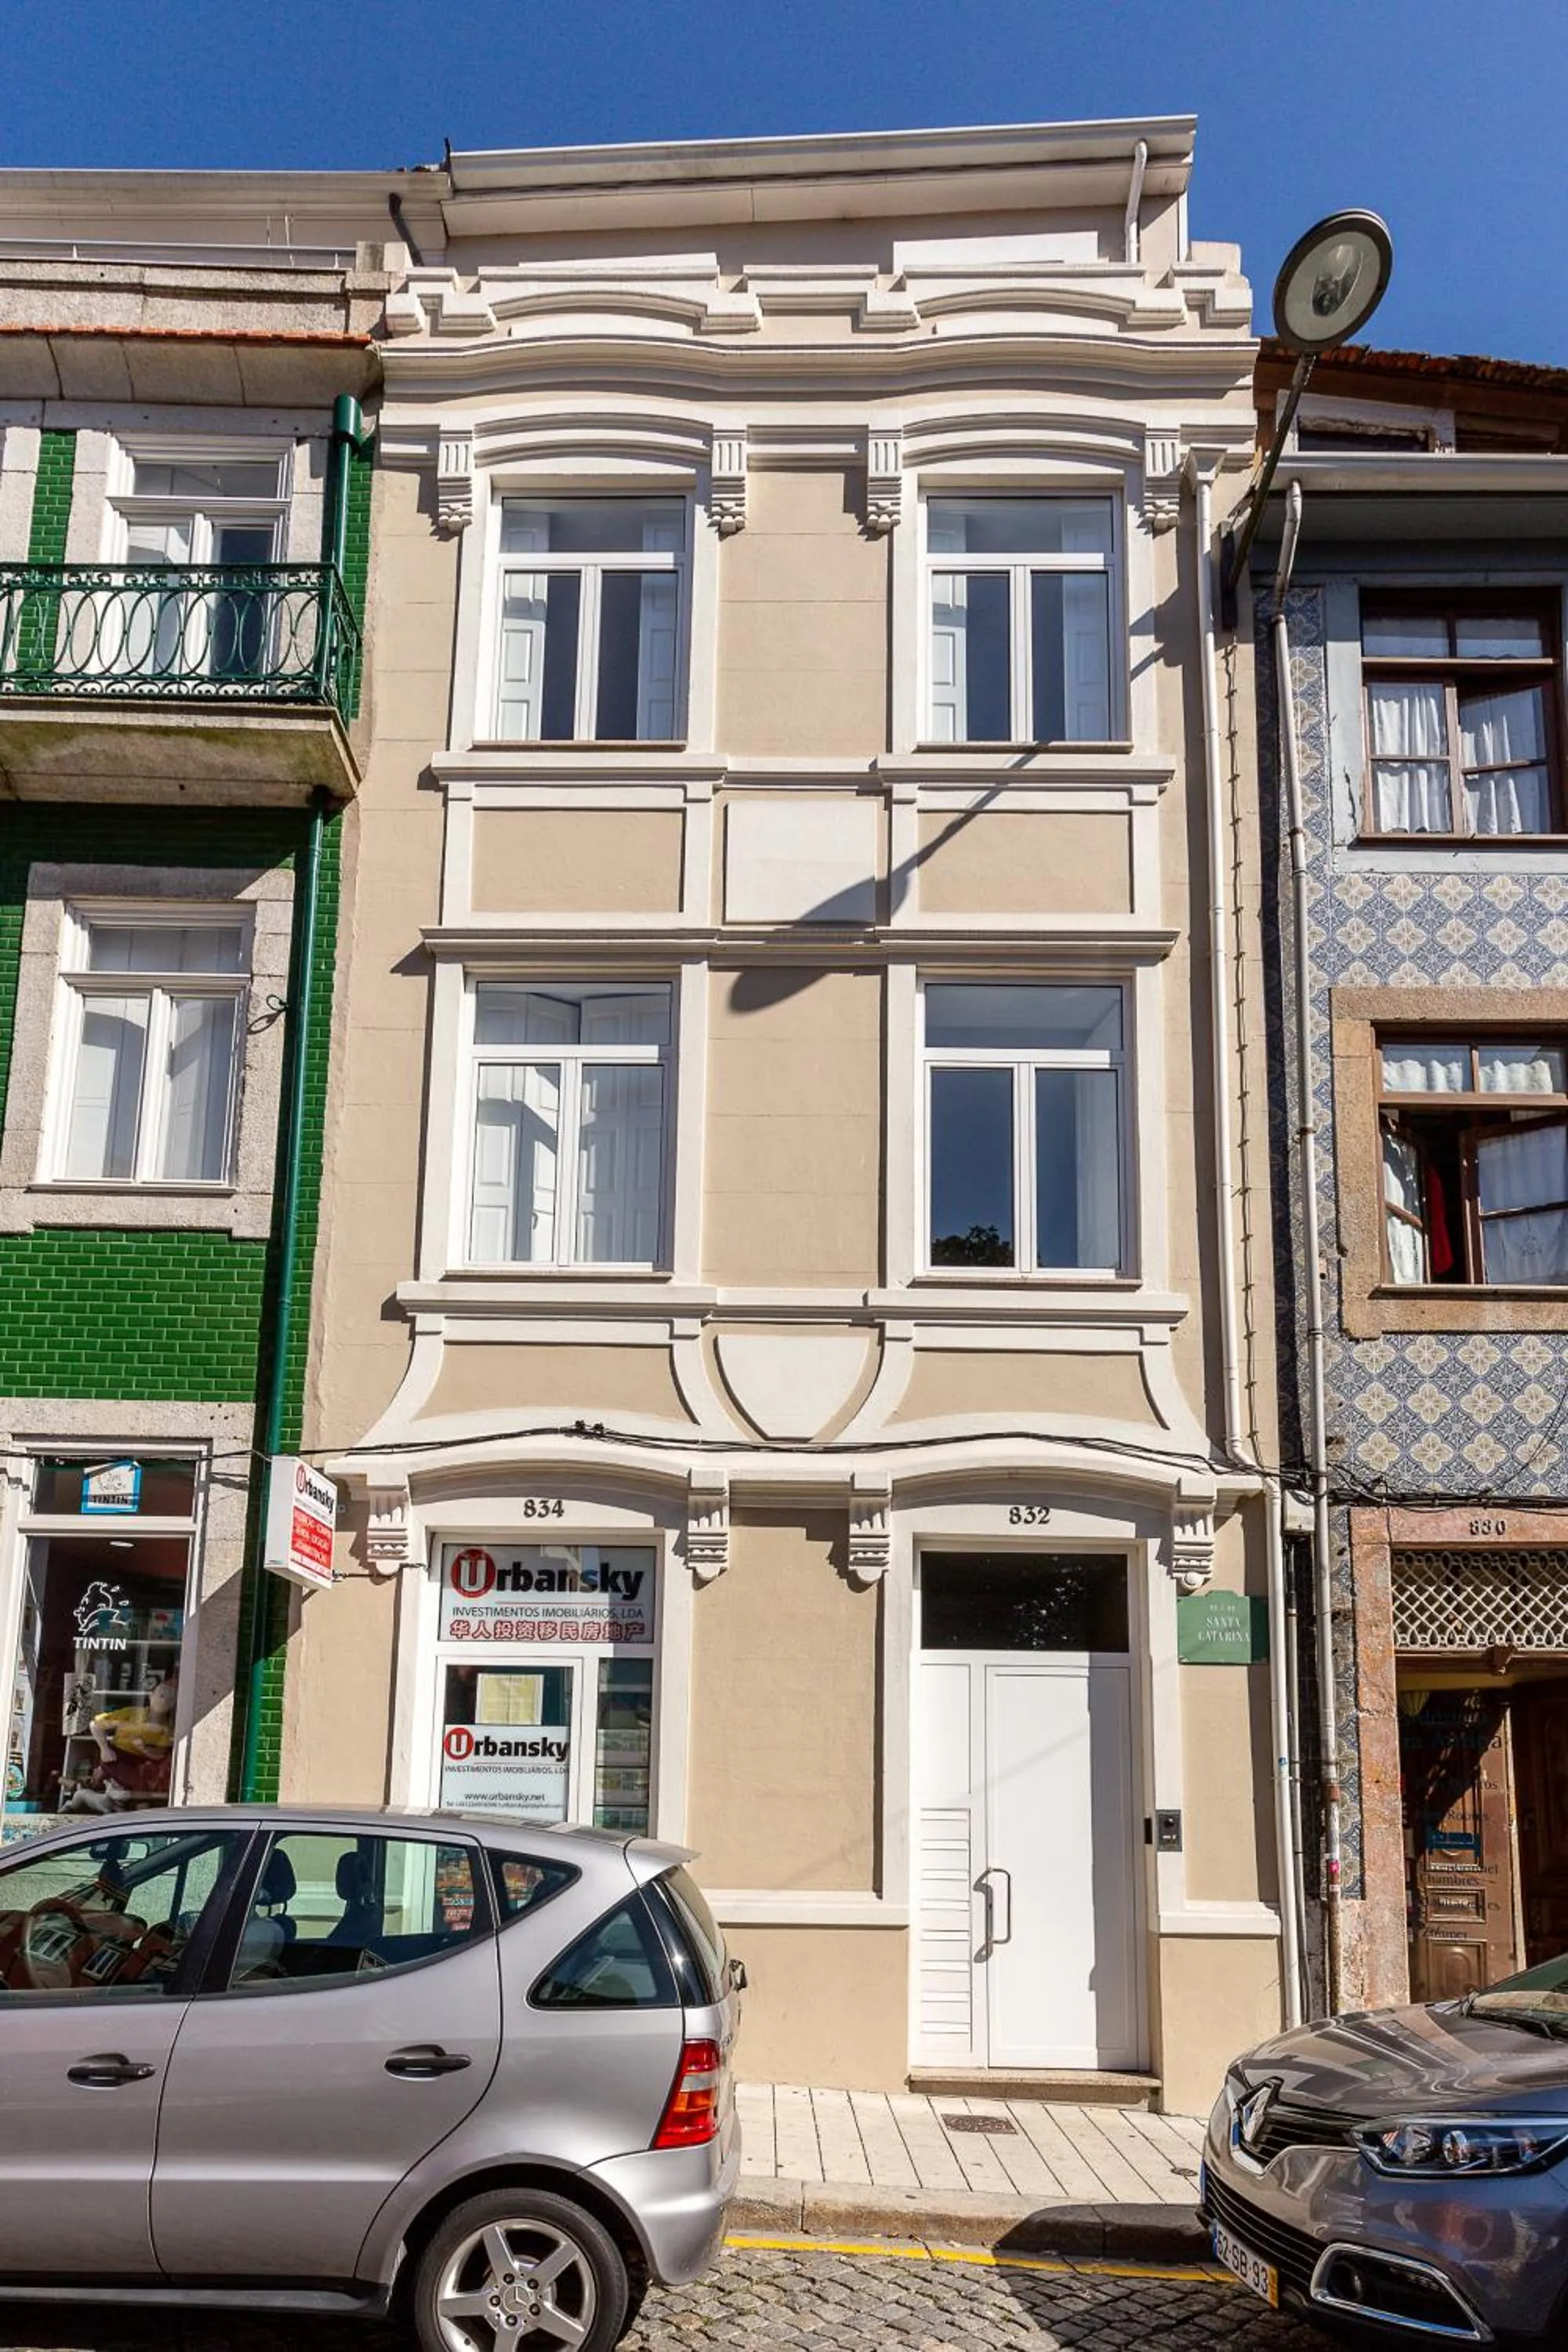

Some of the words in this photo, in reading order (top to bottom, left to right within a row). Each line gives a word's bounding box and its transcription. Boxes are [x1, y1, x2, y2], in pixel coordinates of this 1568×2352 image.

[296, 1464, 335, 1514] Urbansky
[524, 1499, 564, 1518] 834
[1009, 1506, 1051, 1525] 832
[451, 1548, 644, 1601] Urbansky
[452, 1606, 540, 1617] INVESTIMENTOS
[622, 1609, 644, 1619] LDA
[450, 1619, 644, 1641] 华人投资移民房地产
[1206, 1617, 1241, 1628] SANTA
[73, 1637, 126, 1650] TINTIN
[1198, 1630, 1251, 1642] CATARINA
[445, 1727, 570, 1762] Urbansky
[464, 1791, 545, 1802] www.urbansky.net
